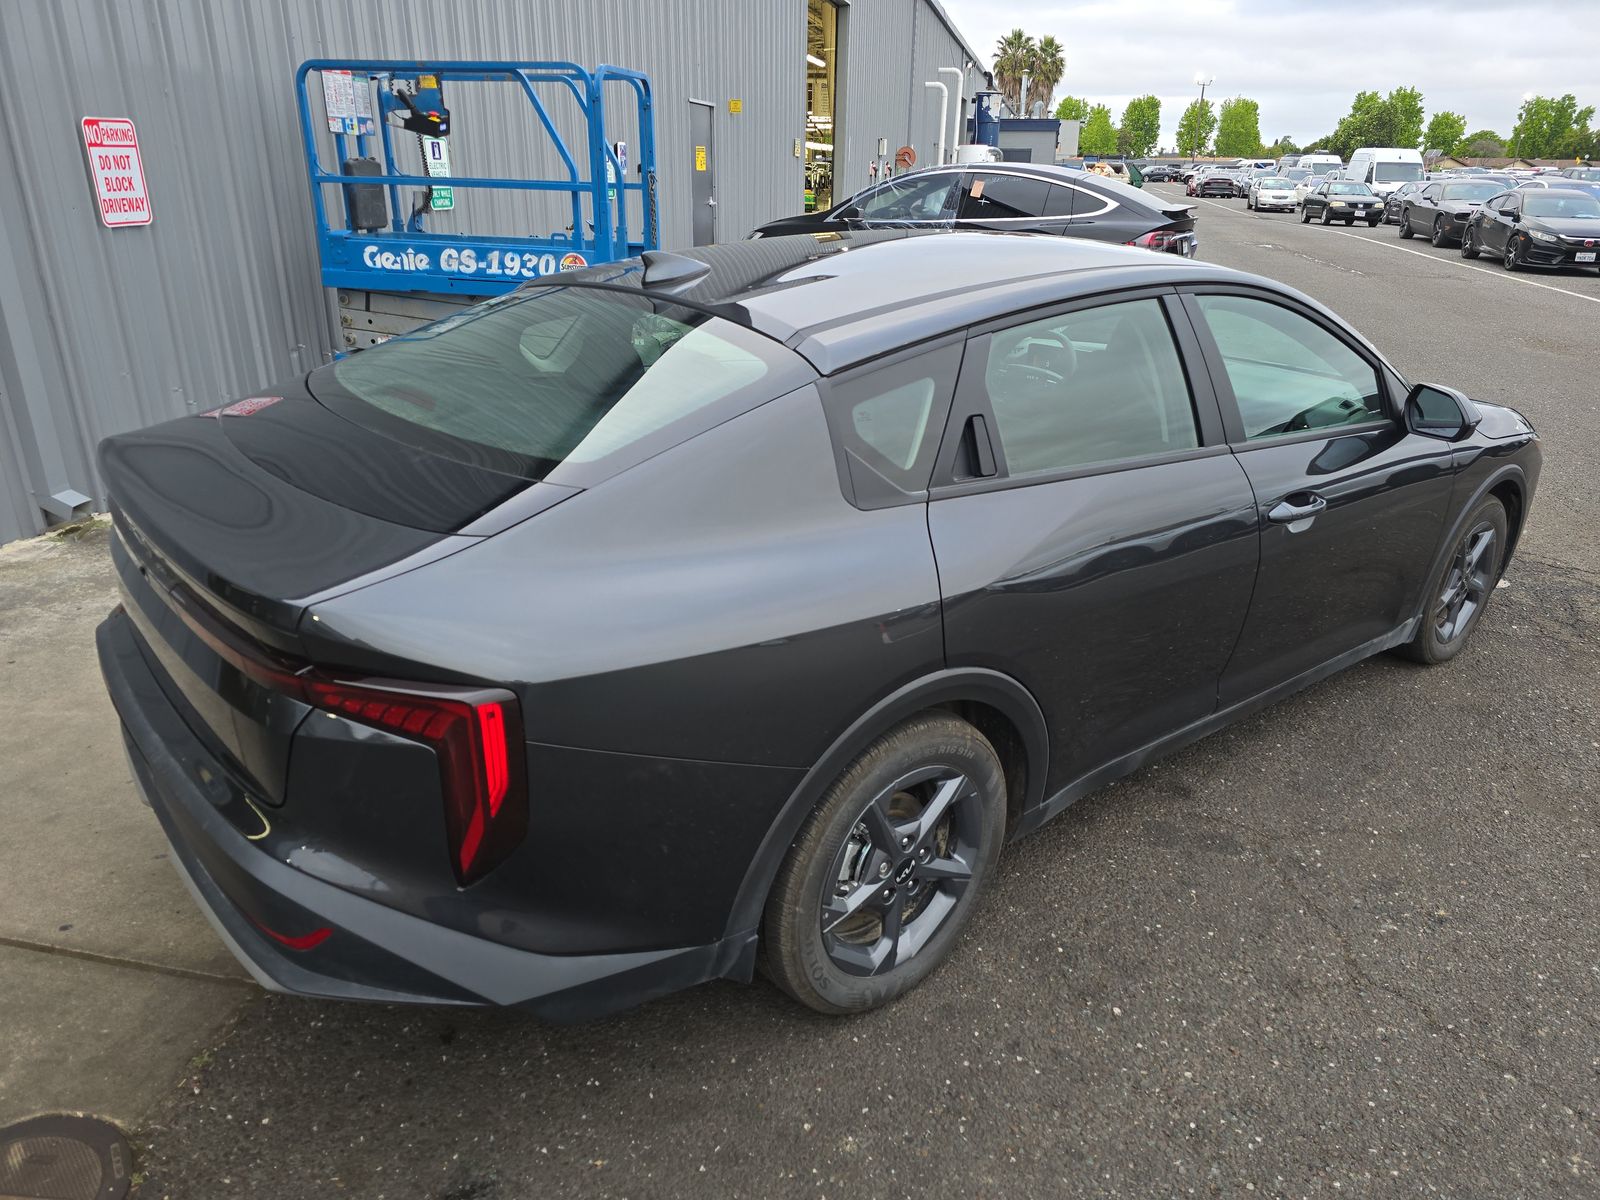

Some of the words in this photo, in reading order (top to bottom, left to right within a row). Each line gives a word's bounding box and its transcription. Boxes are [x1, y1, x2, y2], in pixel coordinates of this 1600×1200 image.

[84, 124, 102, 144] NO
[101, 127, 133, 142] PARKING
[98, 155, 111, 170] DO
[112, 155, 132, 170] NOT
[104, 176, 135, 193] BLOCK
[102, 197, 145, 214] DRIVEWAY
[363, 245, 430, 271] Genie
